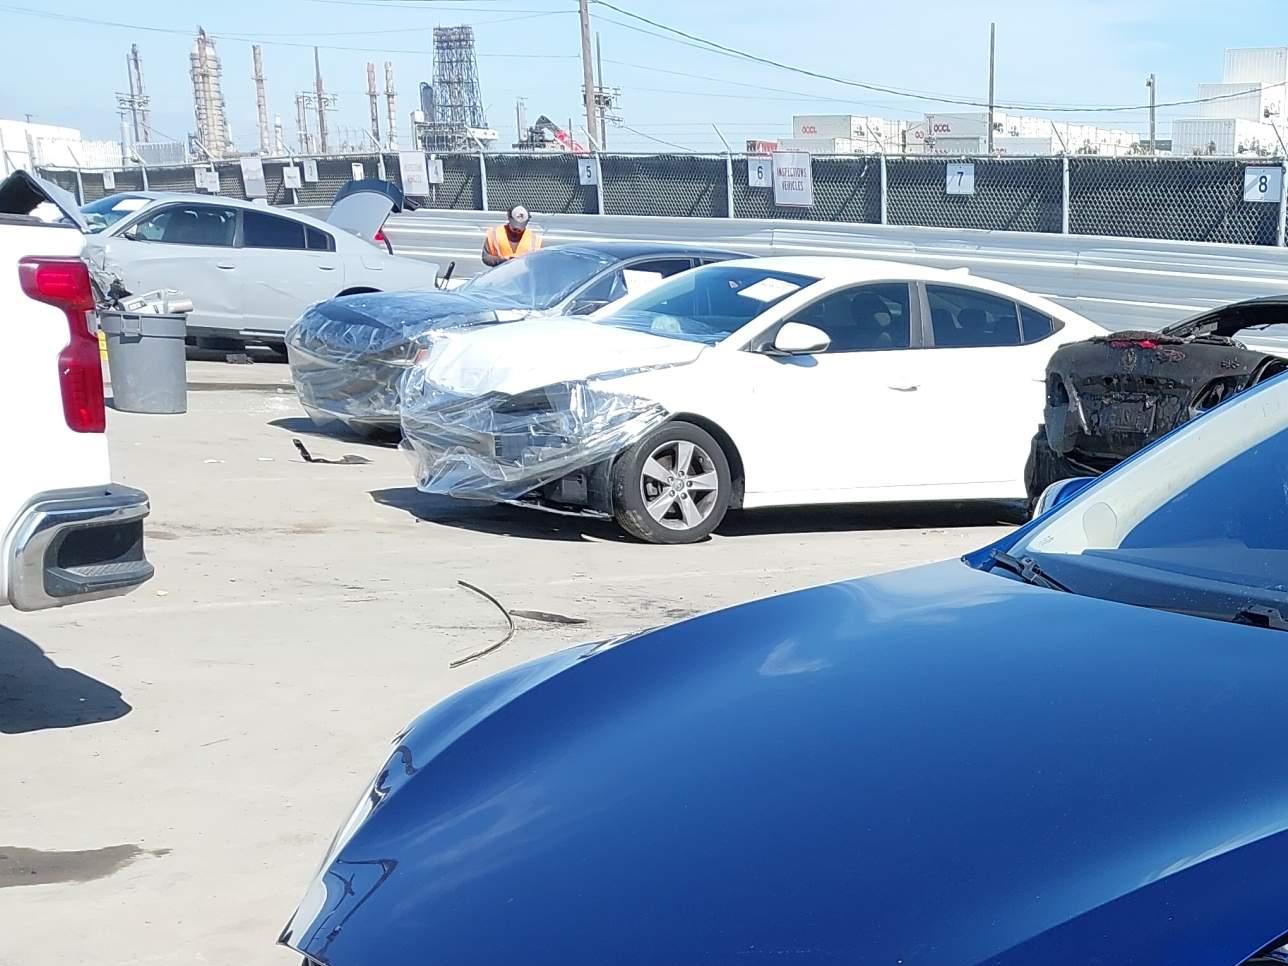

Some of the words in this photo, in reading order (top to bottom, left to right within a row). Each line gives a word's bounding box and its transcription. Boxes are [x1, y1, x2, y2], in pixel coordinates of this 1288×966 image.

[586, 165, 592, 179] 5
[757, 166, 764, 180] 6
[957, 171, 964, 187] 7
[1258, 175, 1268, 194] 8
